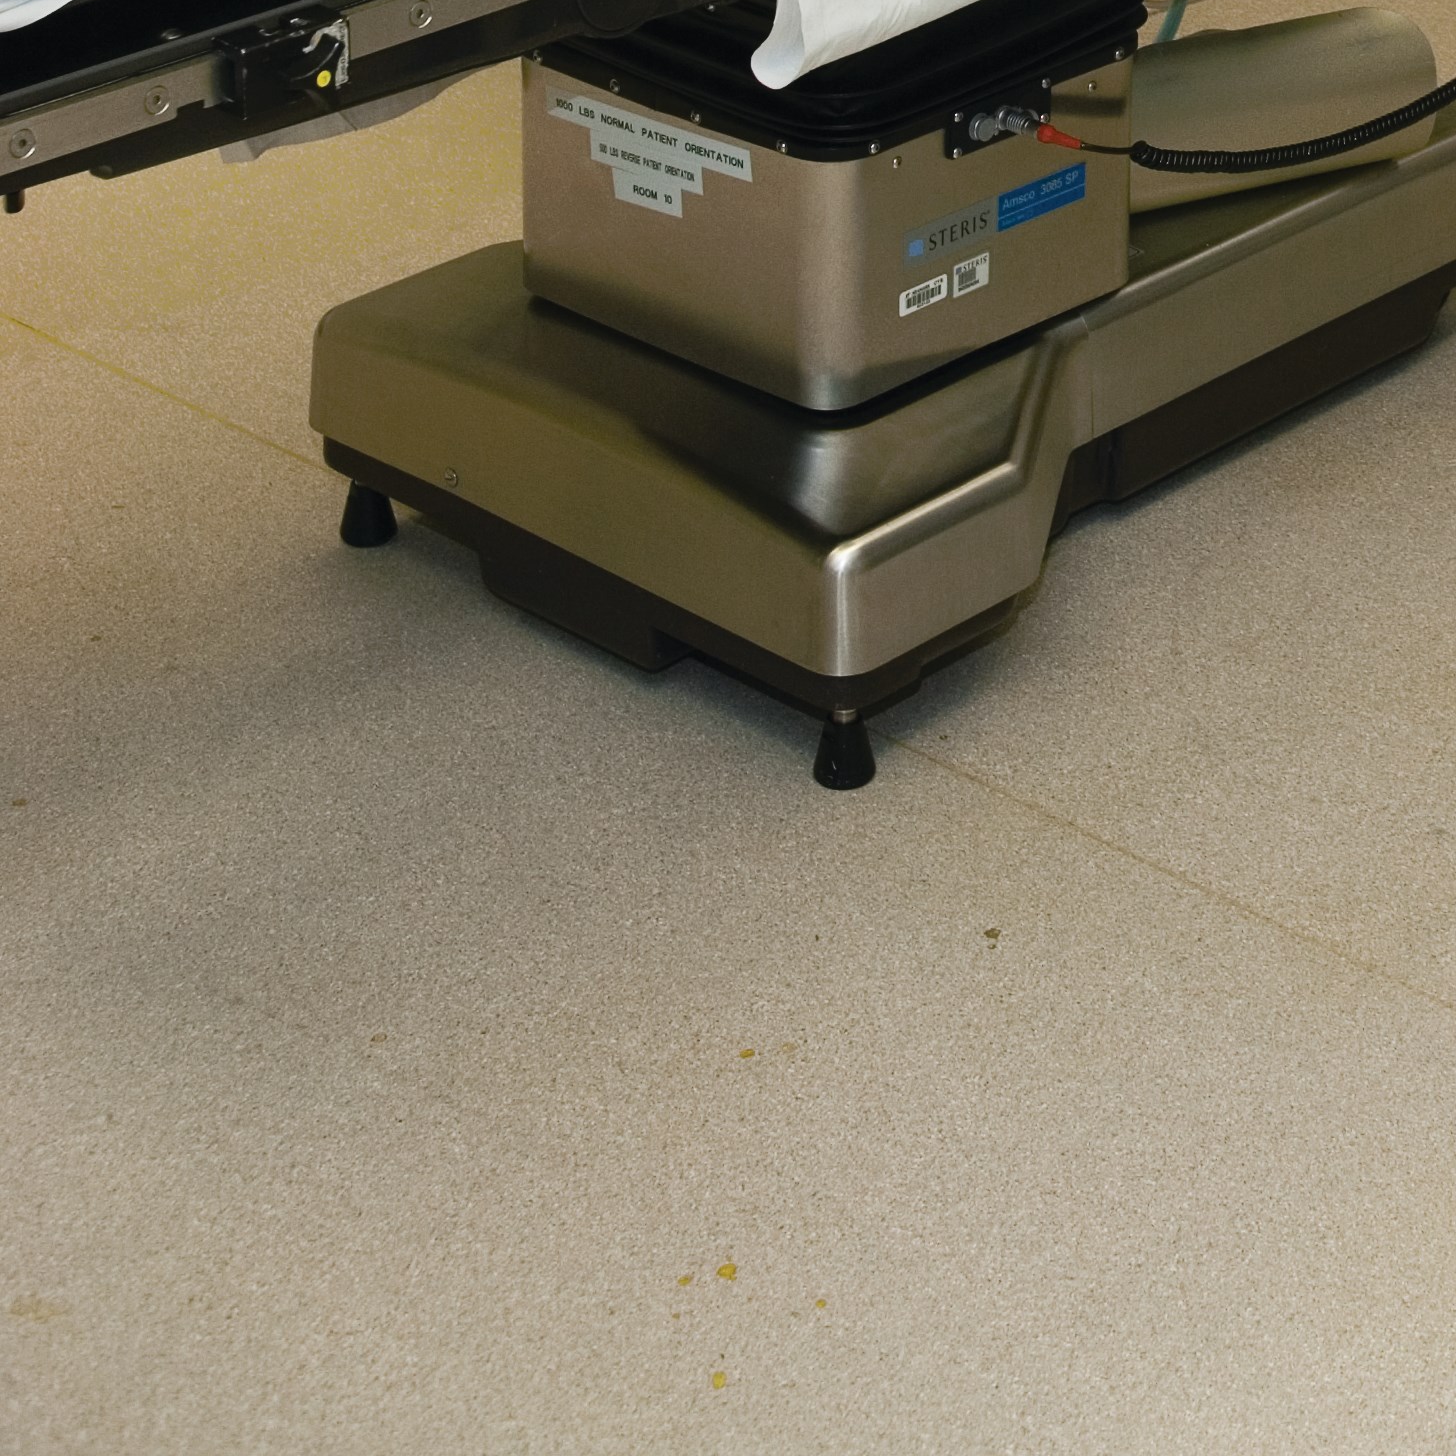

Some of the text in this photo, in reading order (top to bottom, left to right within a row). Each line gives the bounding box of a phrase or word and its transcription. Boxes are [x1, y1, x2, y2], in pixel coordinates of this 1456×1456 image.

[555, 98, 744, 169] 1000 LBS NORMAL PATIENT ORIENTATION
[621, 150, 641, 165] REVERSE
[643, 157, 662, 171] PATIENT
[665, 164, 695, 182] ORIENTATION
[633, 184, 673, 205] ROOM 10
[1002, 190, 1036, 211] Amsco
[1065, 169, 1079, 185] SP
[928, 211, 989, 252] STERIS
[963, 254, 988, 271] STERIS
